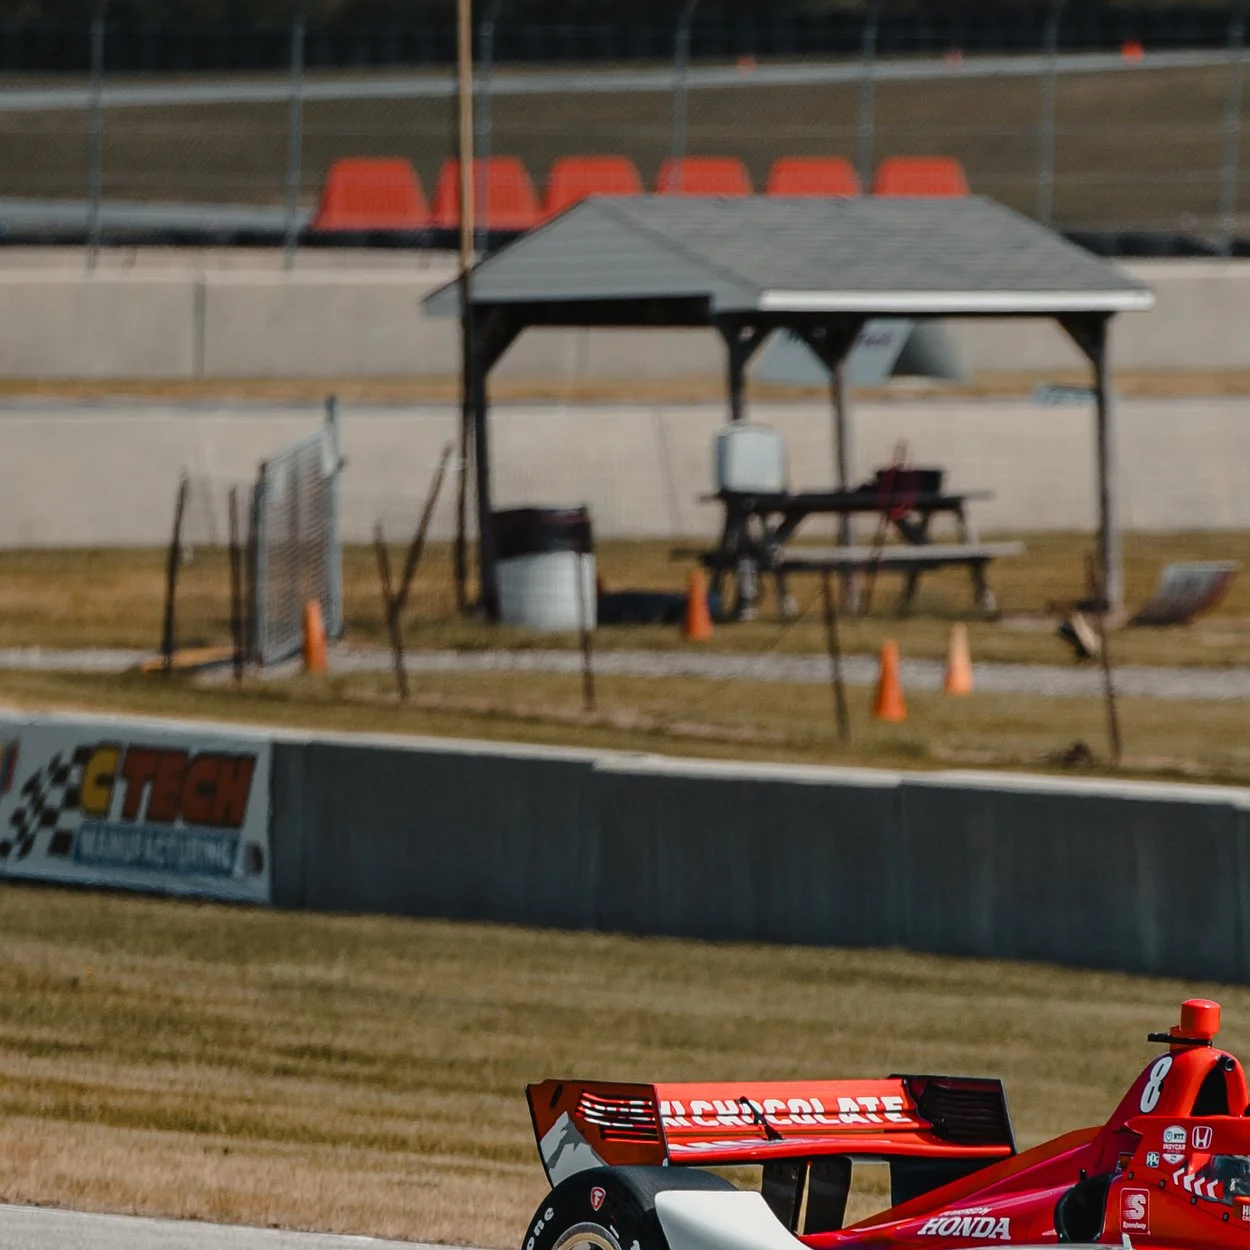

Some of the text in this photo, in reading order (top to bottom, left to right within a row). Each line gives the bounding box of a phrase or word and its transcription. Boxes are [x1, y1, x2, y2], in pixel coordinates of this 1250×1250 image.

[1140, 1056, 1173, 1114] 8
[689, 1096, 913, 1128] CHOCOLATE
[917, 1216, 1011, 1240] HONDA
